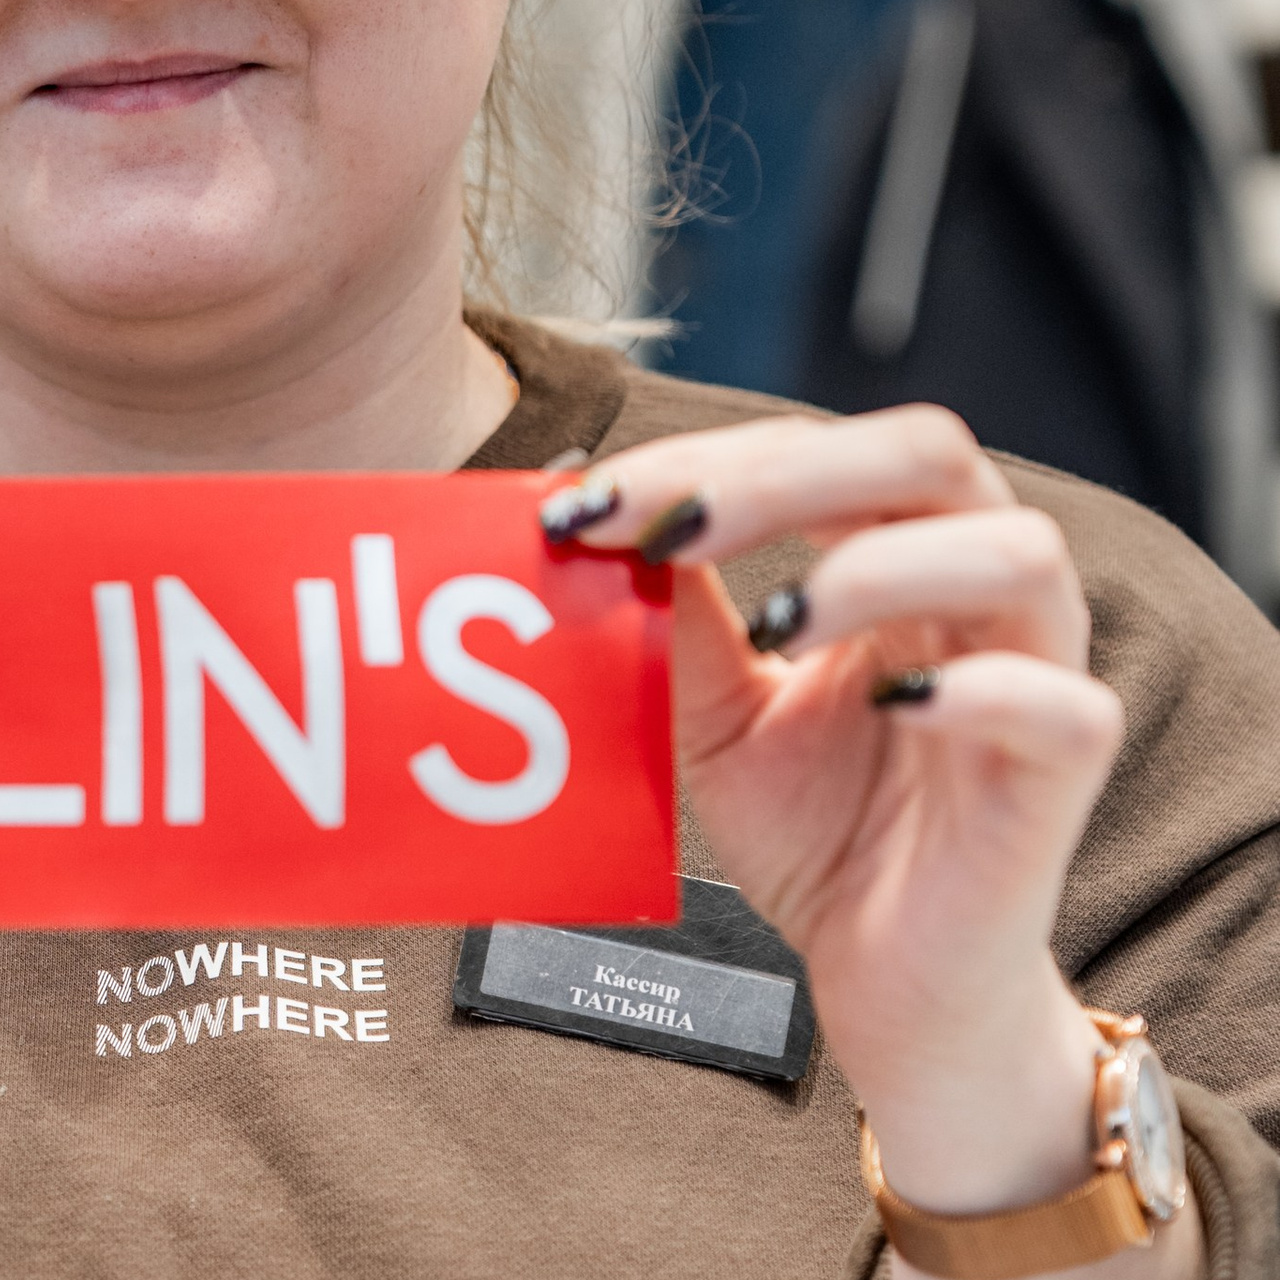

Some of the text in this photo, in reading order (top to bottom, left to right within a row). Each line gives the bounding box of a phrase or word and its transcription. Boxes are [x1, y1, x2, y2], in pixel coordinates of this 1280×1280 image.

[96, 941, 387, 1005] NOWHERE
[593, 964, 681, 1004] Кассир
[95, 994, 390, 1058] NOWHERE
[569, 986, 695, 1032] ТАТЬЯНА
